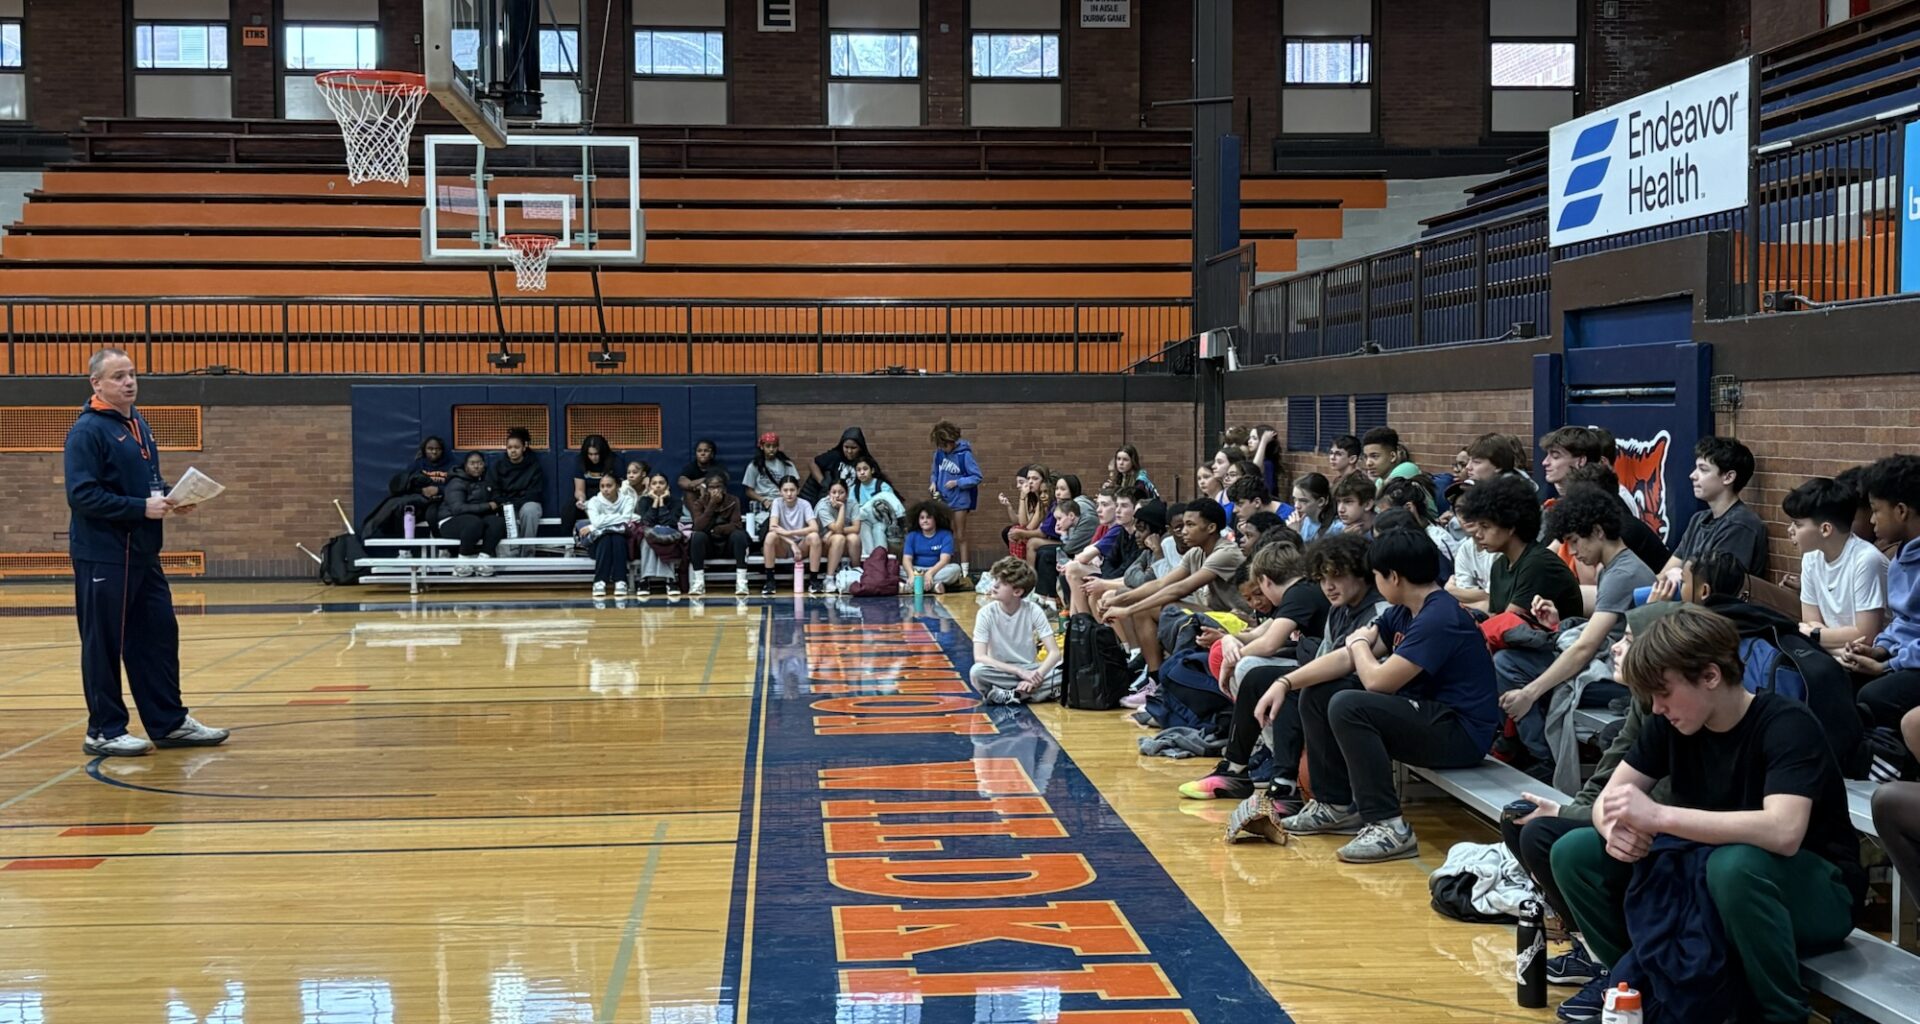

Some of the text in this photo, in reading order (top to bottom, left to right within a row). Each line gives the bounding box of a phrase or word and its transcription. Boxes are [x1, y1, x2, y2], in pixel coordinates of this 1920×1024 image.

[764, 0, 791, 26] E
[1083, 14, 1127, 22] DURING GAME
[1090, 4, 1118, 12] IN AISLE
[1629, 91, 1739, 159] Endeavor
[1629, 152, 1699, 215] Health
